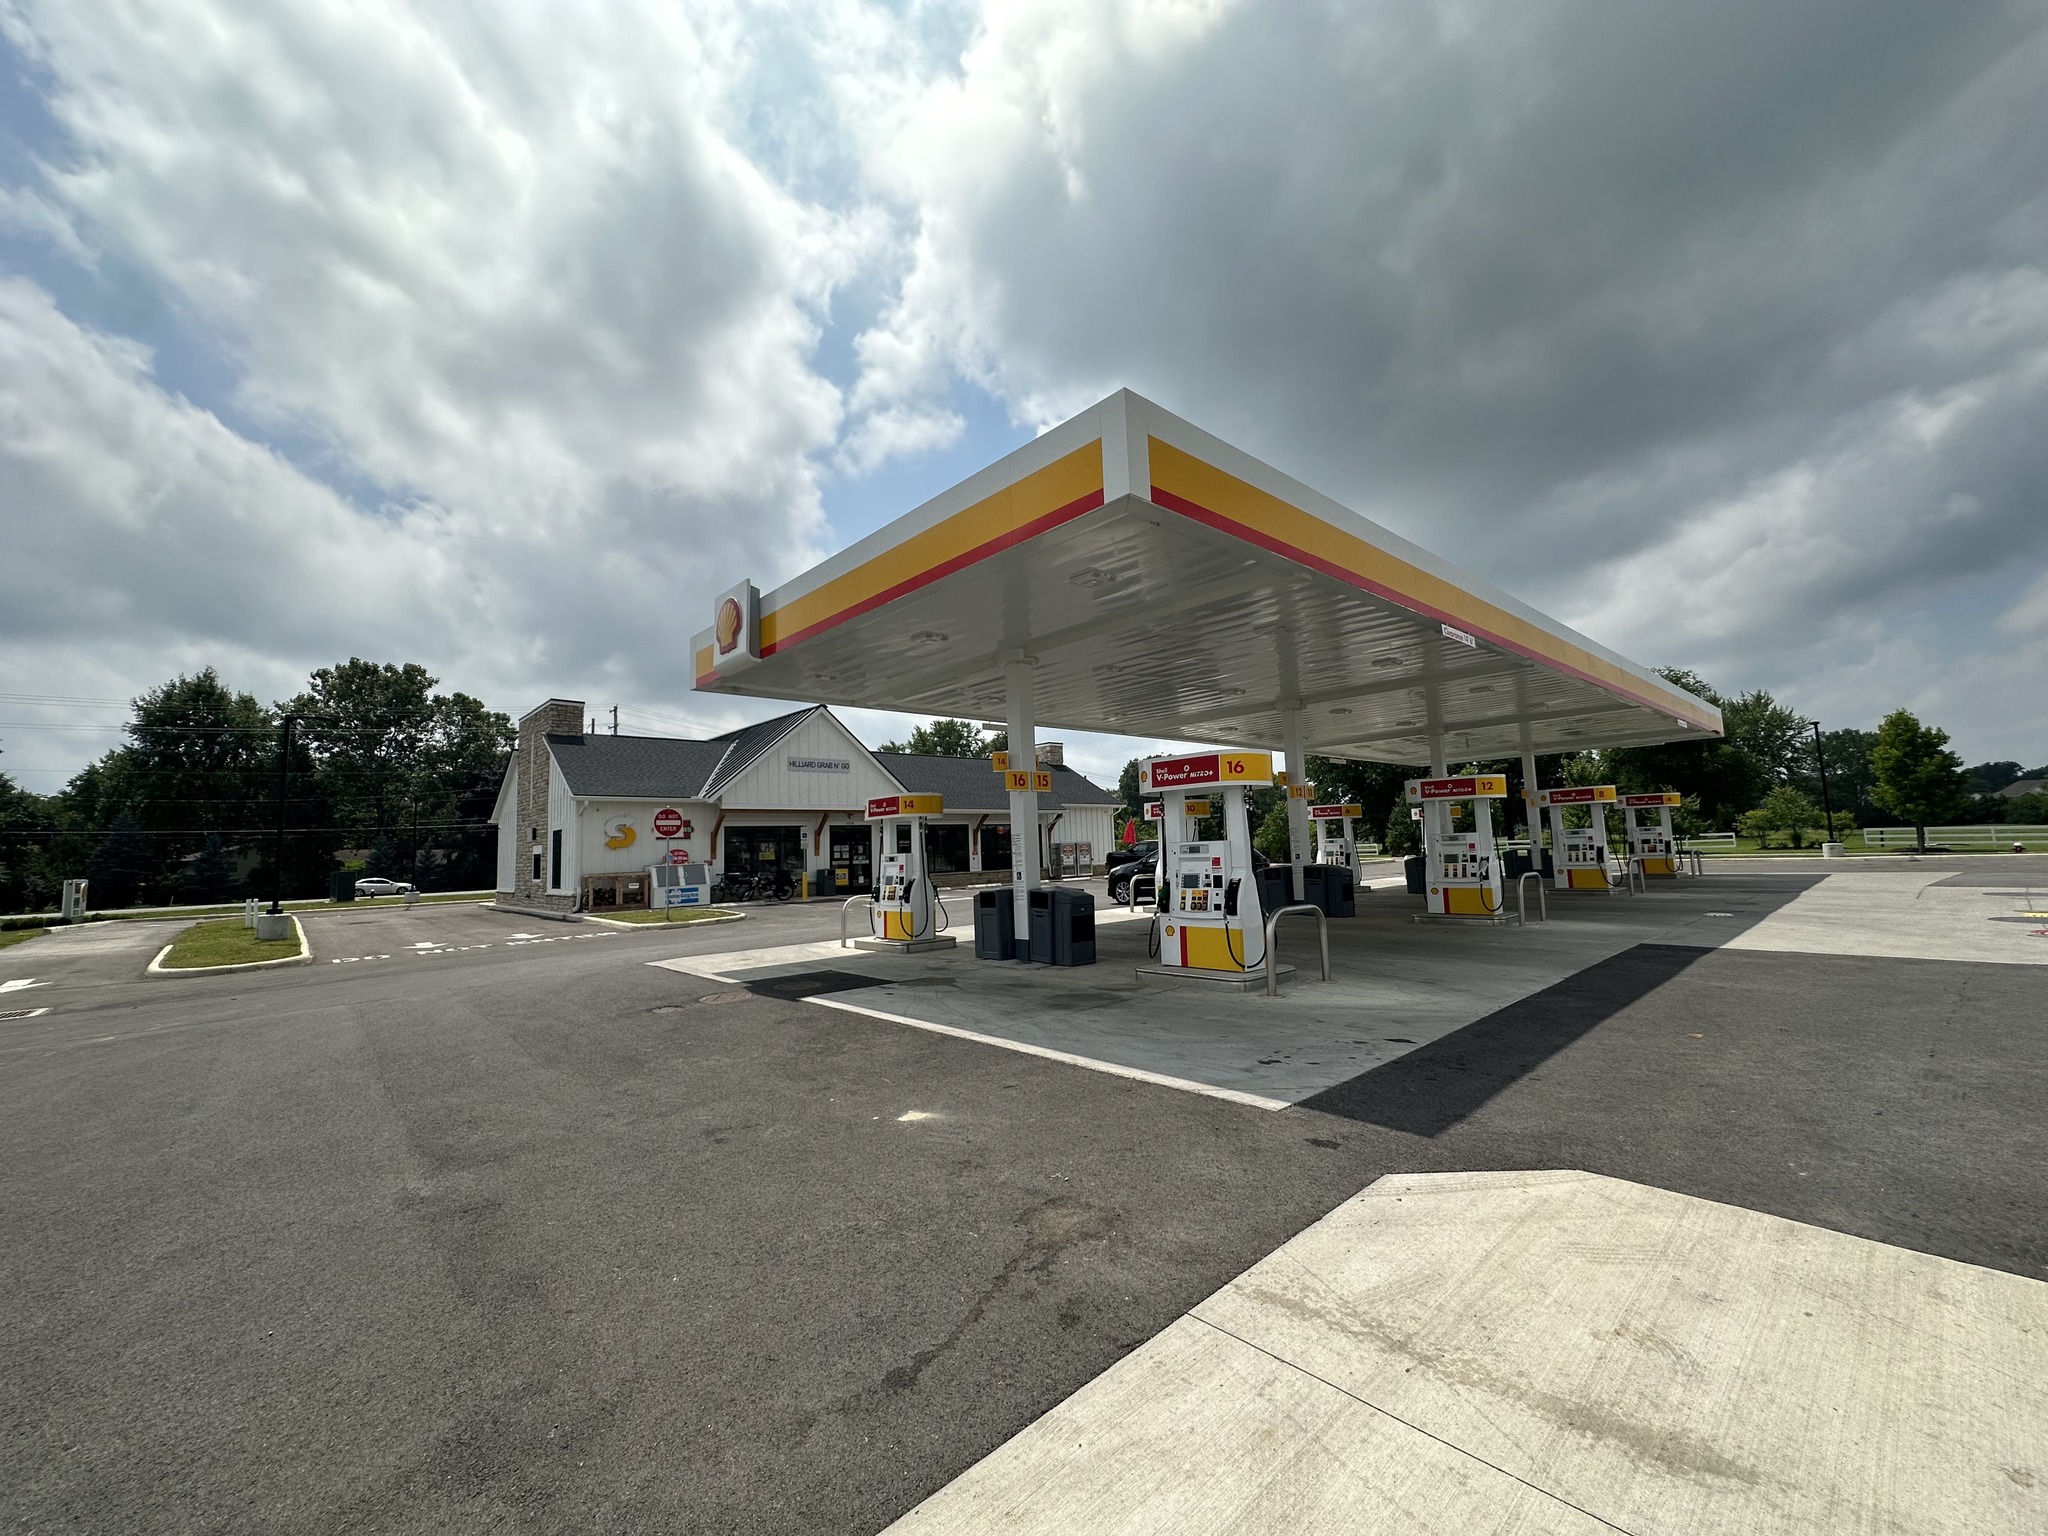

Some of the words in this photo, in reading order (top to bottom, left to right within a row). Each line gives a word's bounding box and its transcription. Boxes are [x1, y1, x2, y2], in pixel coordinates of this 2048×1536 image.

[789, 760, 816, 768] HILLIARD
[817, 761, 833, 769] GRAB
[997, 757, 1006, 766] 14
[1226, 760, 1245, 774] 16
[1012, 773, 1026, 787] 16
[1036, 774, 1049, 787] 15
[1156, 773, 1188, 781] V-Power
[1481, 781, 1493, 791] 12
[1295, 787, 1303, 797] 12
[903, 800, 915, 810] 14
[1186, 804, 1196, 812] 10
